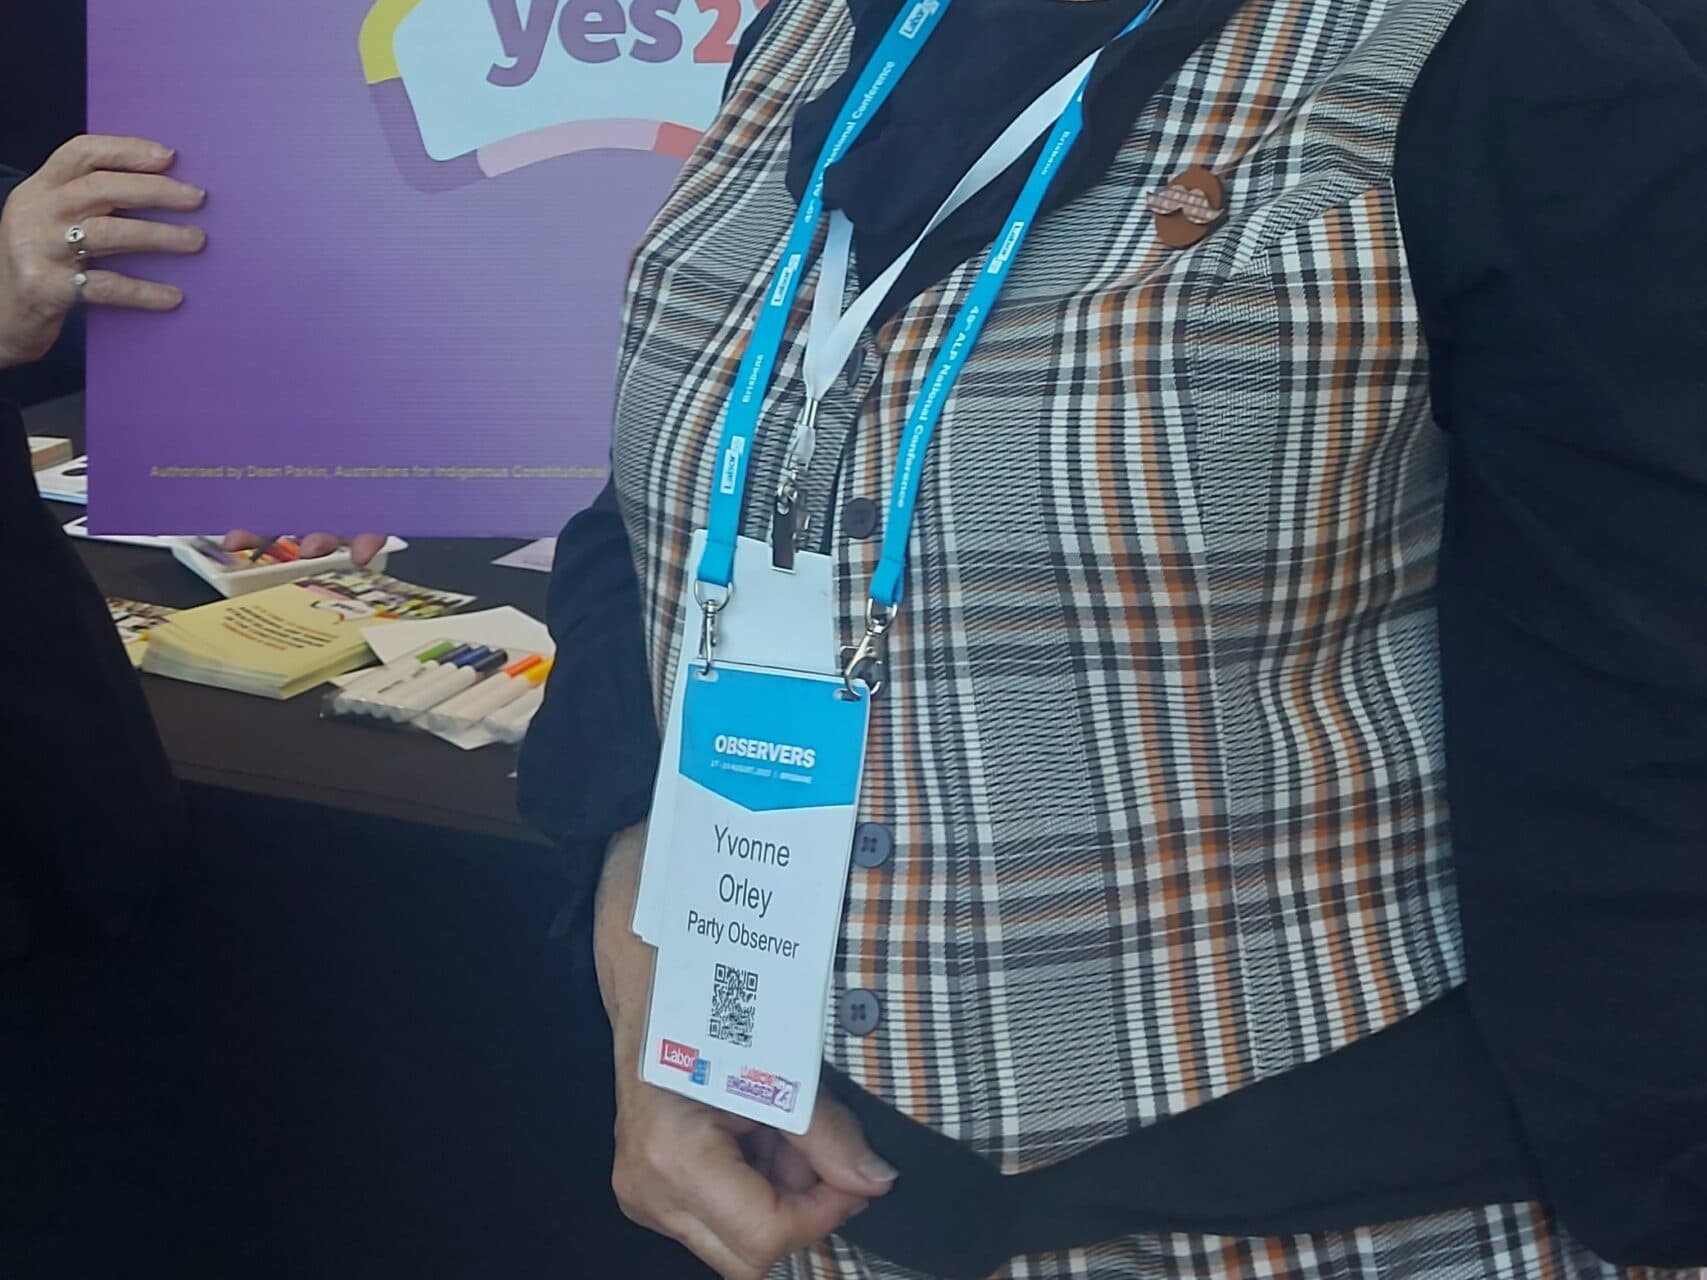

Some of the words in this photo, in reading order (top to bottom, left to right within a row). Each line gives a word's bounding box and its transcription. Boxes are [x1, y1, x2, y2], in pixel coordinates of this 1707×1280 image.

[851, 60, 896, 120] Conference
[741, 353, 764, 404] Brisbane
[918, 363, 952, 422] National
[227, 466, 243, 480] by
[412, 465, 431, 478] for
[897, 424, 925, 509] Conference
[714, 734, 816, 769] OBSERVERS
[714, 823, 791, 868] Yvonne
[718, 873, 774, 919] Orley
[687, 910, 725, 945] Party
[728, 921, 800, 959] Observer
[664, 1043, 696, 1069] Labor
